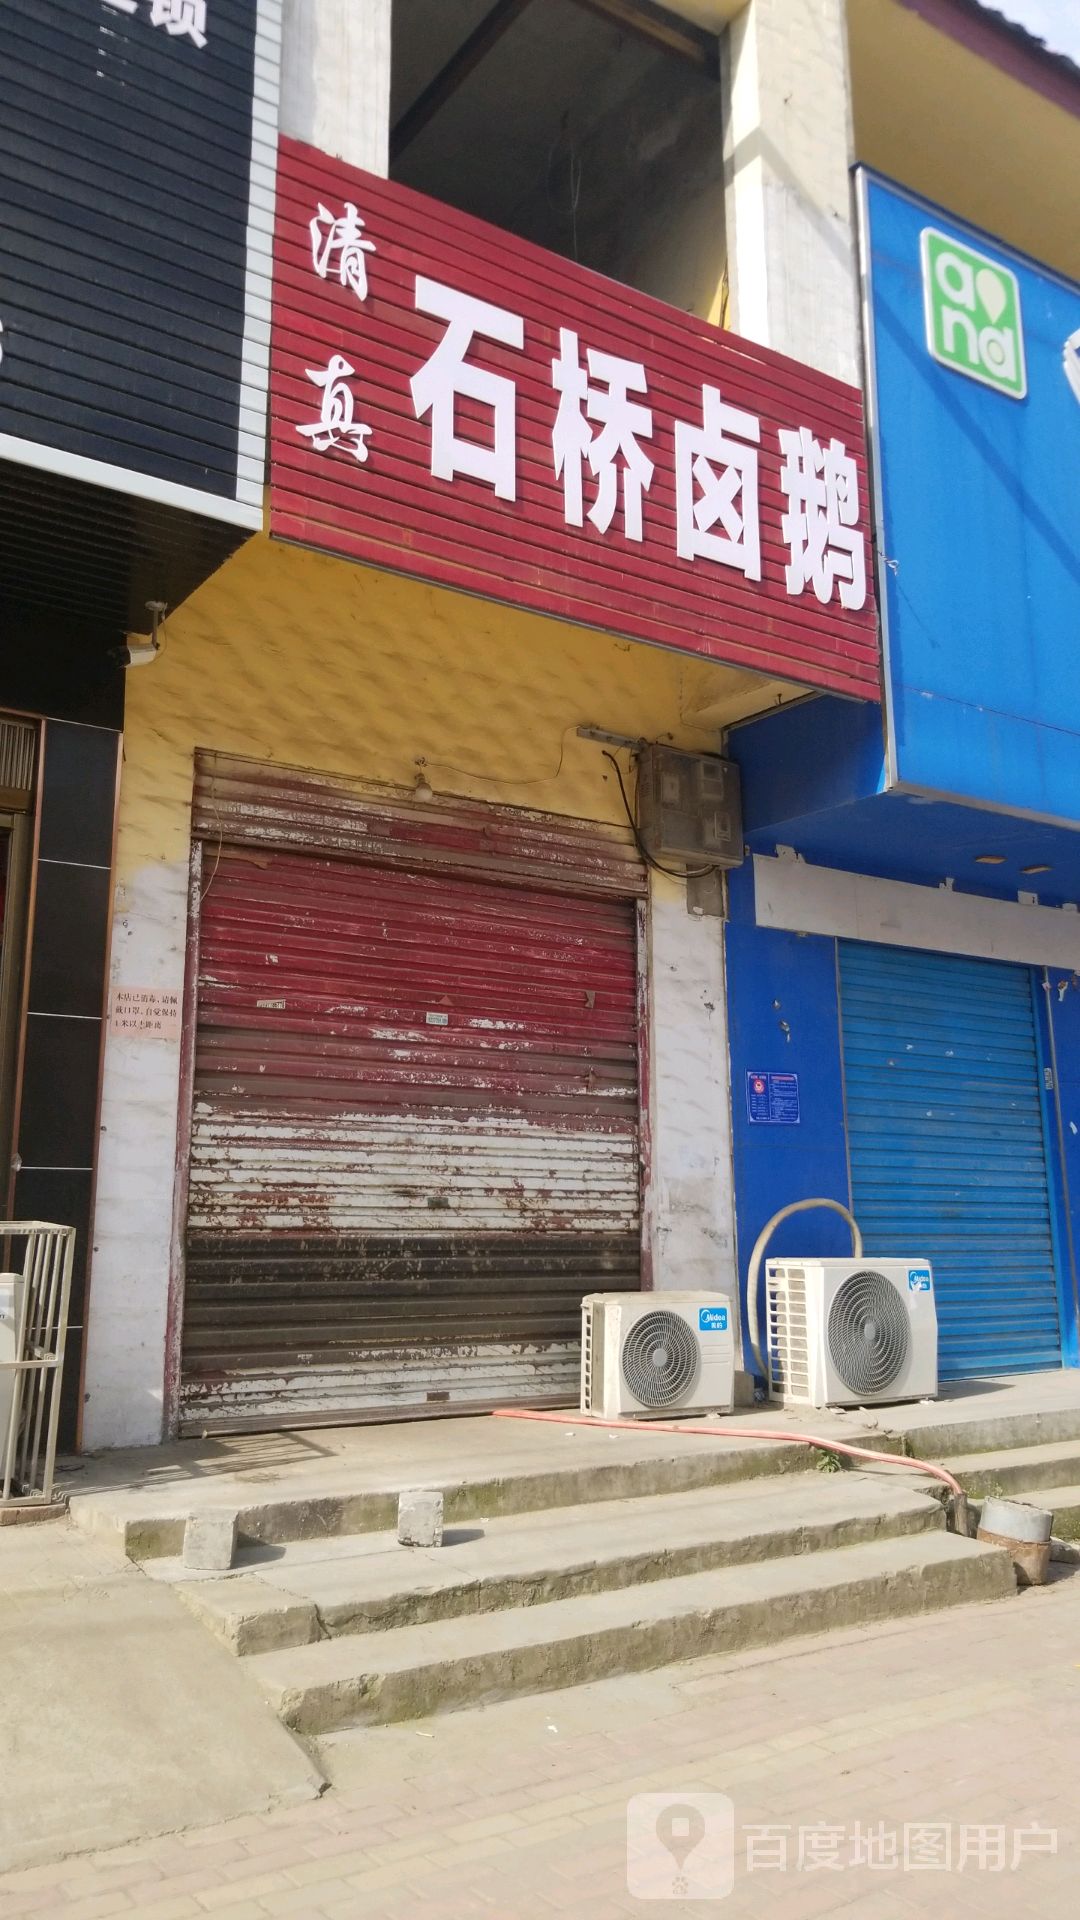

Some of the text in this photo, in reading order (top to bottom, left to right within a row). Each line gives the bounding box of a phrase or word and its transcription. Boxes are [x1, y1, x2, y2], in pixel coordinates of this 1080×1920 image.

[295, 201, 377, 463] 清真
[409, 274, 868, 612] 石桥卤鹅
[702, 1311, 726, 1322] Midea
